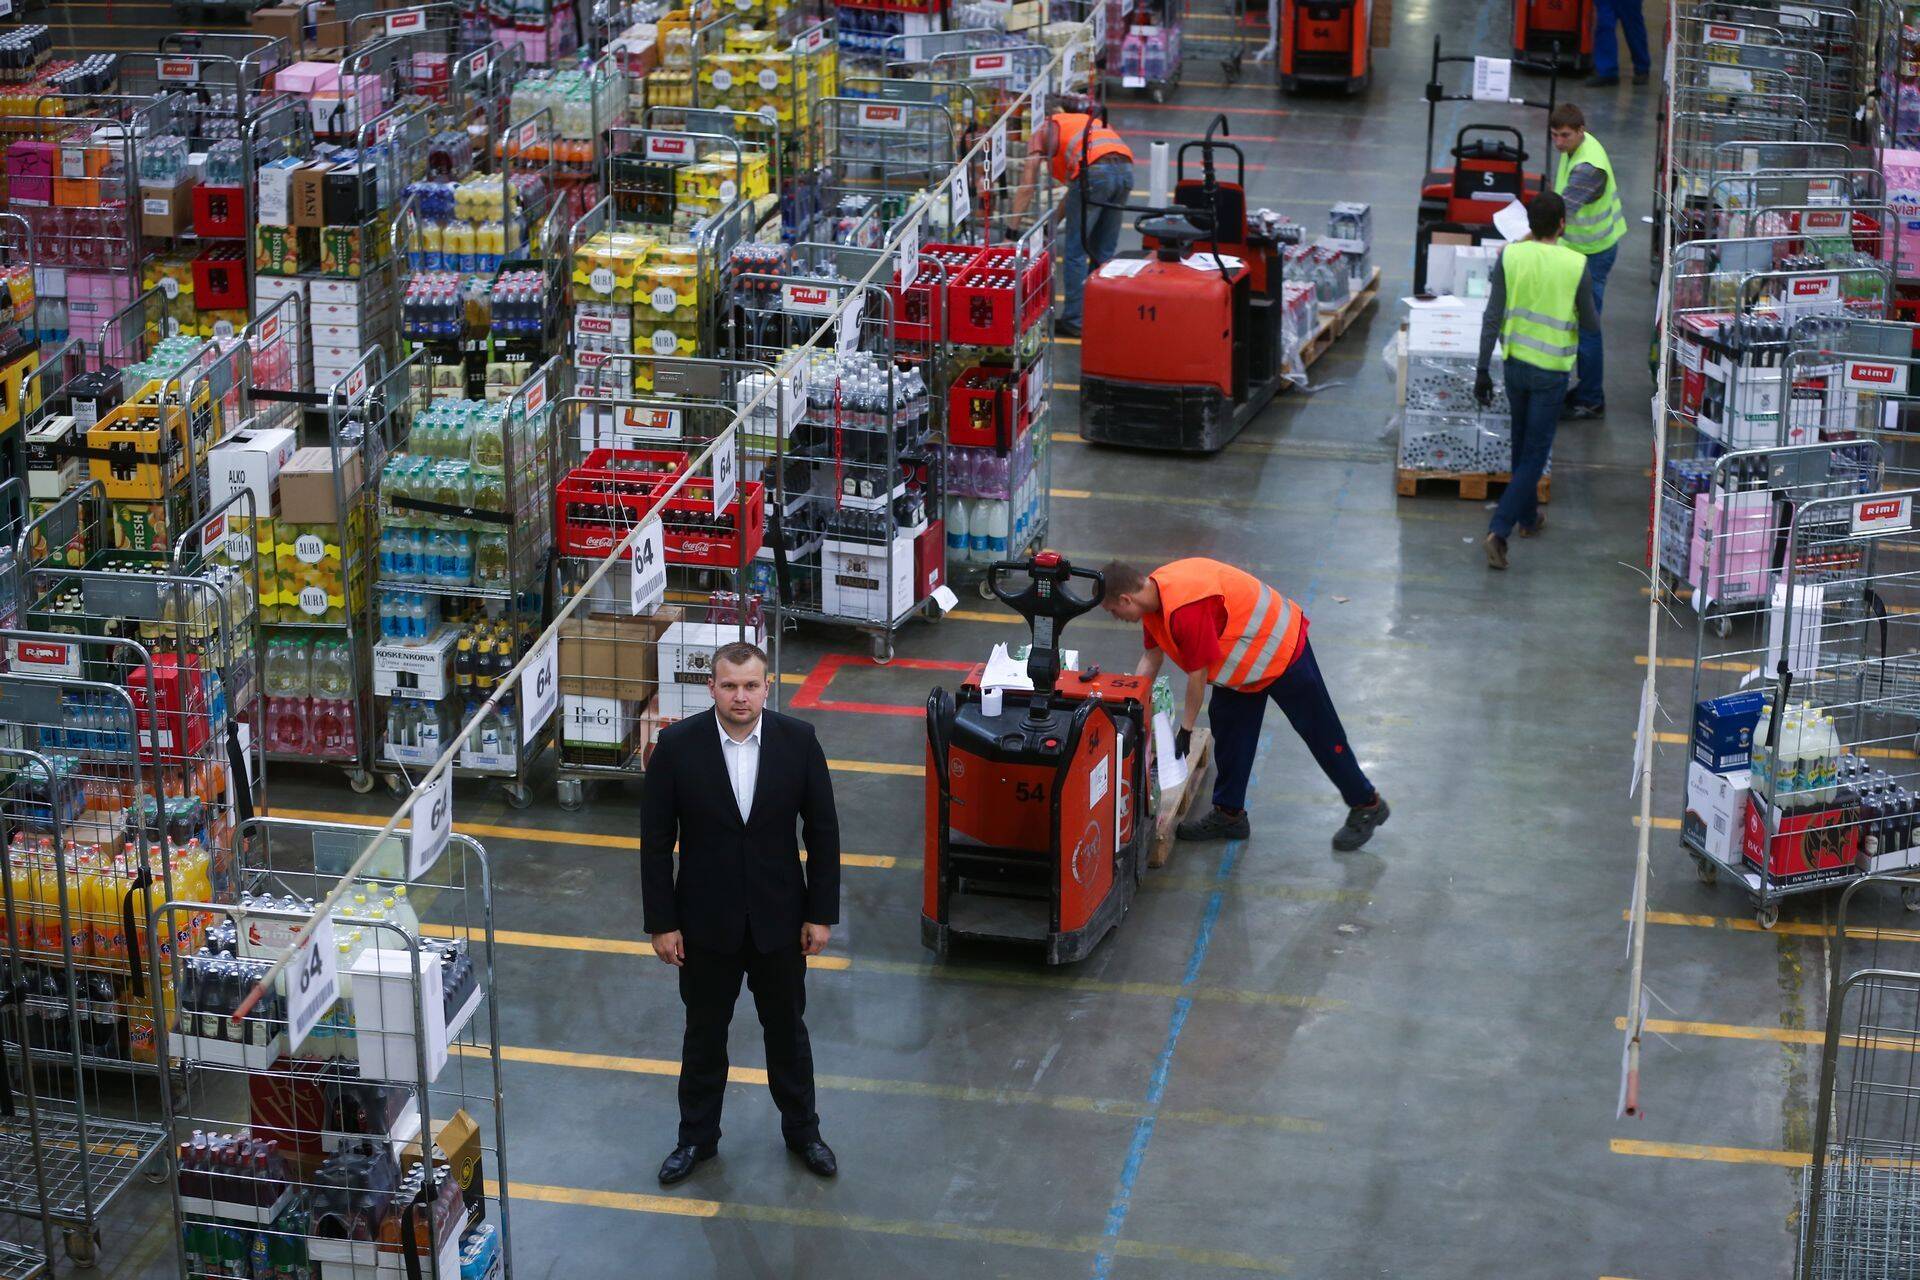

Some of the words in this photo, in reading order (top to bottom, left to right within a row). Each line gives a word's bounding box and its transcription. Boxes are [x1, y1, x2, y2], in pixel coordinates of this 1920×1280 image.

[1483, 171, 1495, 186] 5
[305, 181, 317, 218] MASI
[272, 233, 281, 260] FRESH
[654, 293, 674, 305] AURA
[1137, 304, 1157, 322] 11
[654, 336, 675, 348] AURA
[1858, 367, 1889, 378] Rimi
[792, 369, 804, 399] 64
[228, 470, 246, 484] ALKO
[720, 455, 731, 483] 64
[1866, 503, 1896, 516] Rimi
[134, 514, 145, 550] FRESH
[299, 543, 321, 555] AURA
[634, 537, 654, 575] 64
[302, 595, 325, 607] AURA
[376, 650, 435, 663] KOSKENKORVA
[536, 657, 552, 699] 64
[1109, 678, 1140, 690] 54
[1015, 782, 1046, 803] 54
[430, 792, 447, 831] 64
